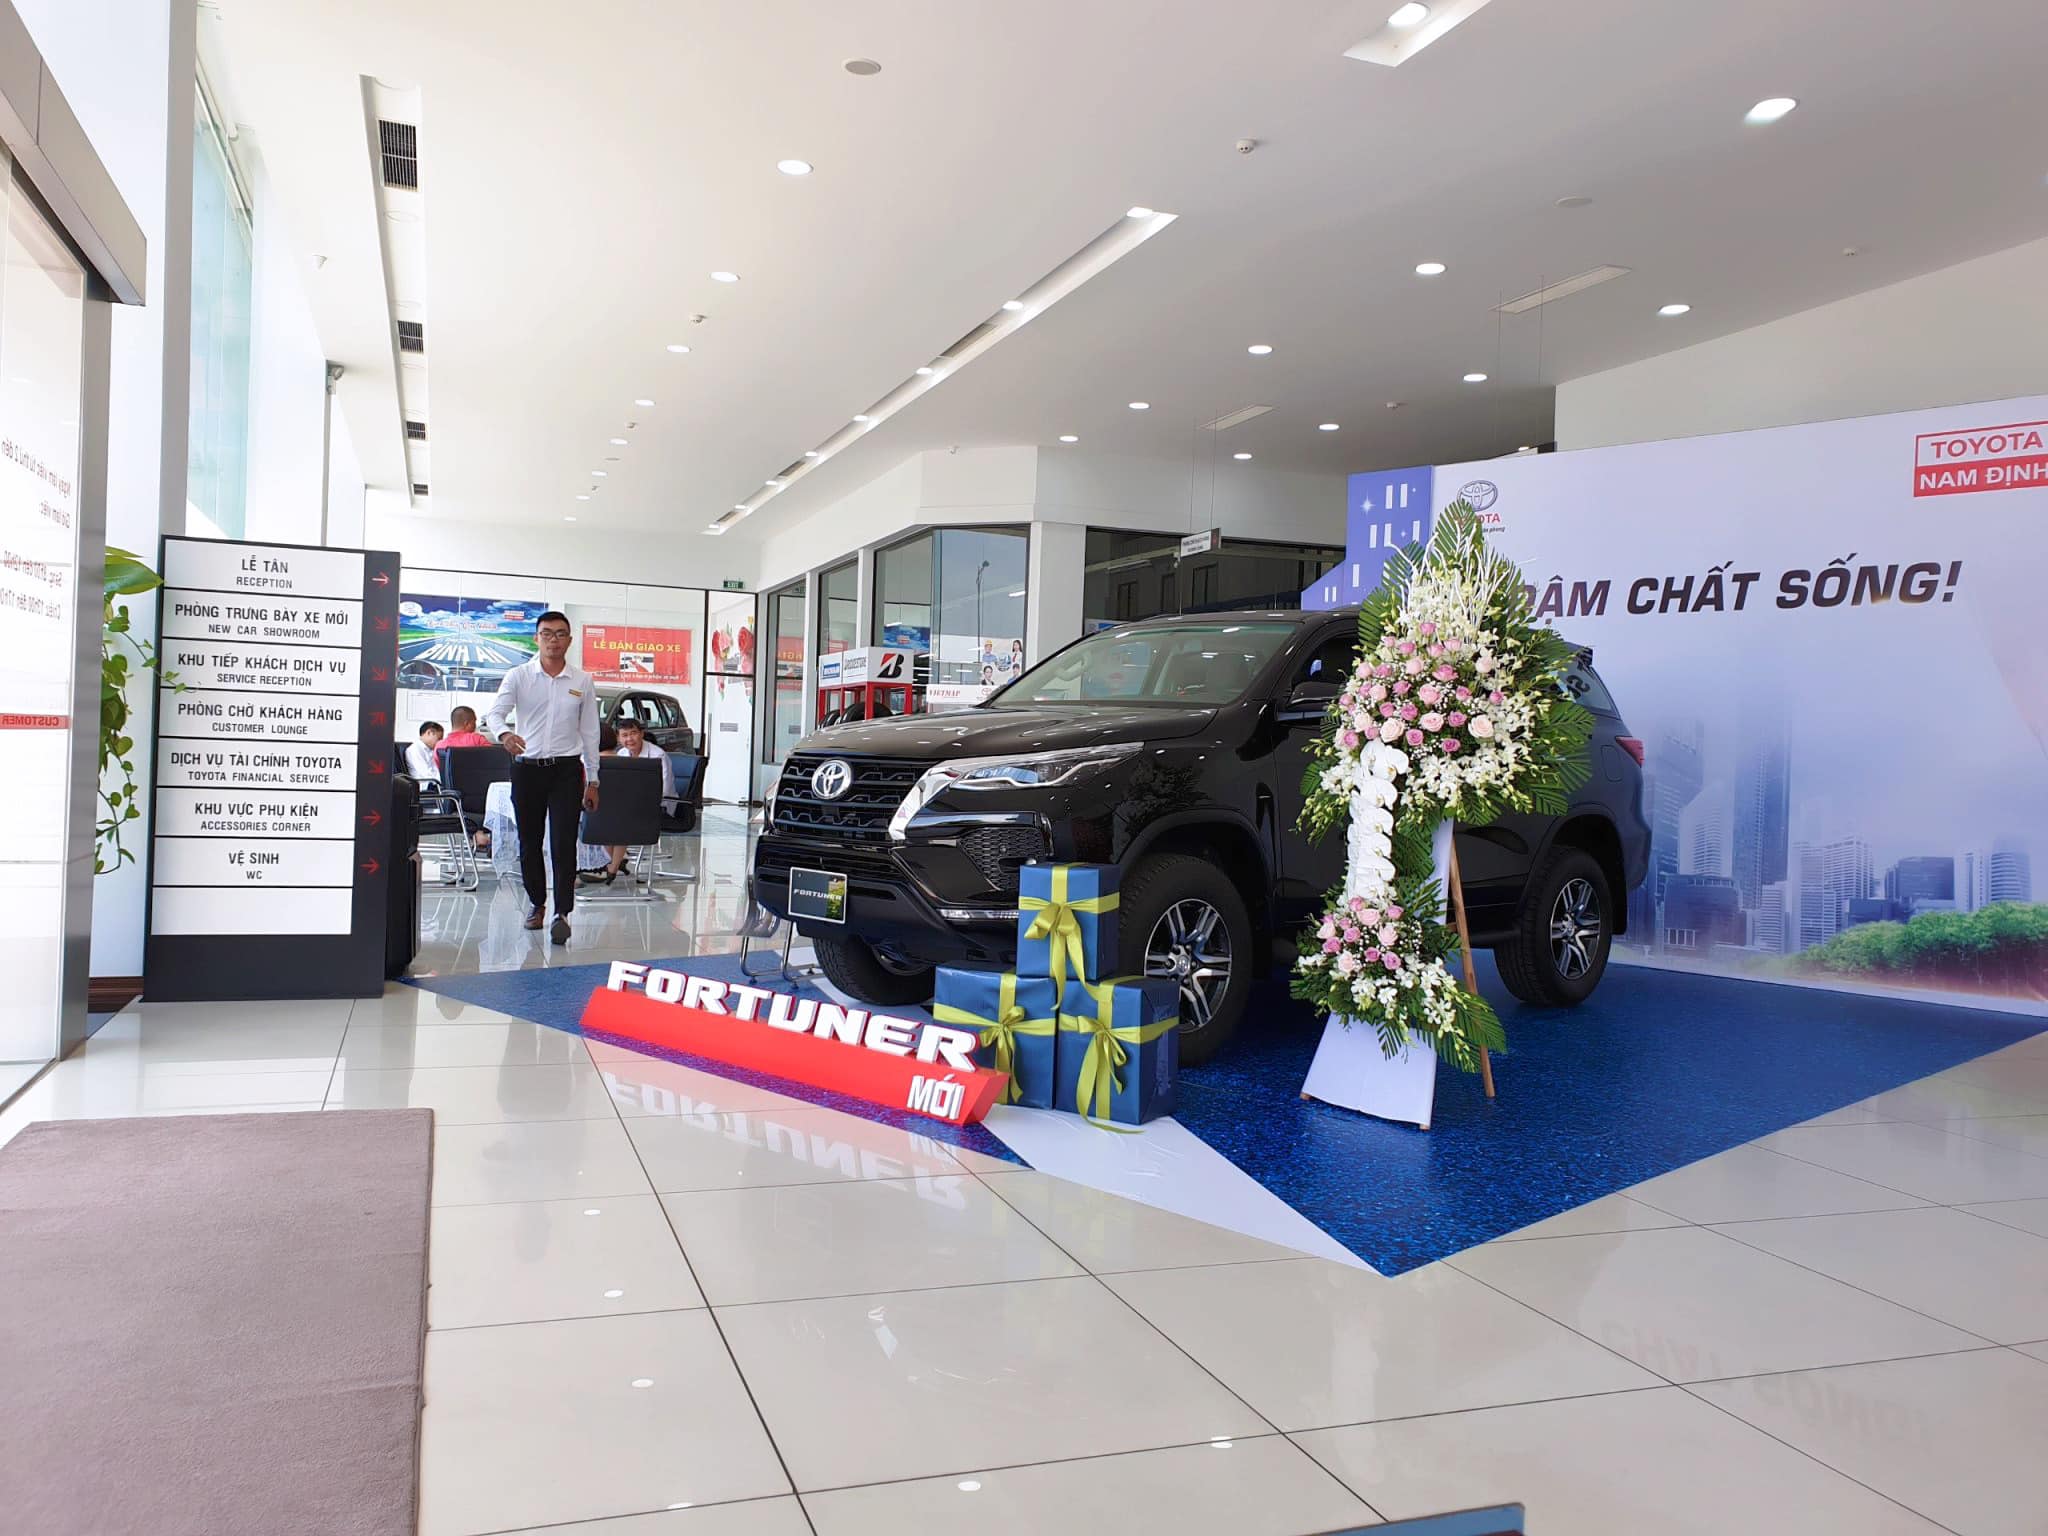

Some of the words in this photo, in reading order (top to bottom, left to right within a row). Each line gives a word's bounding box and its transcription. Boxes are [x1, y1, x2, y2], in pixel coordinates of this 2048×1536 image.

[1931, 431, 2044, 458] TOYOTA
[1920, 469, 1977, 490] NAM
[1985, 463, 2048, 486] ĐỊNH
[241, 555, 257, 571] LỄ
[263, 558, 289, 573] TÂN
[236, 576, 293, 589] RECEPTION
[1627, 560, 1760, 614] CHẤT
[1776, 552, 1963, 609] SỐNG!
[175, 601, 219, 618] PHÒNG
[225, 605, 268, 621] TRƯNG
[273, 607, 298, 622] BÀY
[304, 611, 320, 624] XE
[325, 609, 349, 625] MỚI
[208, 624, 231, 635] NEW
[237, 625, 257, 636] CAR
[263, 627, 320, 639] SHOWROOM
[636, 641, 664, 652] GIAO
[667, 643, 681, 653] XE
[178, 653, 205, 667] KHU
[212, 652, 239, 668] TIẾP
[245, 655, 288, 670] KHÁCH
[294, 659, 323, 674] DỊCH
[329, 661, 346, 676] VỤ
[217, 673, 256, 684] SERVICE
[260, 675, 312, 687] RECEPTION
[178, 700, 223, 717] PHÒNG
[228, 702, 254, 718] CHỜ
[259, 703, 302, 720] KHÁCH
[308, 705, 343, 721] HÀNG
[212, 722, 265, 733] CUSTOMER
[271, 724, 308, 735] LOUNGE
[171, 752, 201, 767] DỊCH
[206, 753, 223, 768] VỤ
[230, 751, 249, 767] TÀI
[253, 752, 290, 768] CHÍNH
[295, 756, 342, 769] TOYOTA
[188, 771, 226, 781] TOYOTA
[232, 773, 284, 783] FINANCIAL
[290, 774, 330, 784] SERVICE
[194, 803, 222, 816] KHU
[228, 802, 254, 818] VỰC
[259, 804, 285, 819] PHỤ
[290, 802, 319, 819] KIỆN
[201, 821, 268, 832] ACCESSORIES
[272, 822, 311, 832] CORNER
[229, 850, 245, 866] VỆ
[249, 852, 280, 865] SINH
[246, 871, 263, 880] WC
[794, 888, 842, 901] FORTUNER
[607, 960, 981, 1073] FORTUNER
[907, 1074, 965, 1121] MỚI
